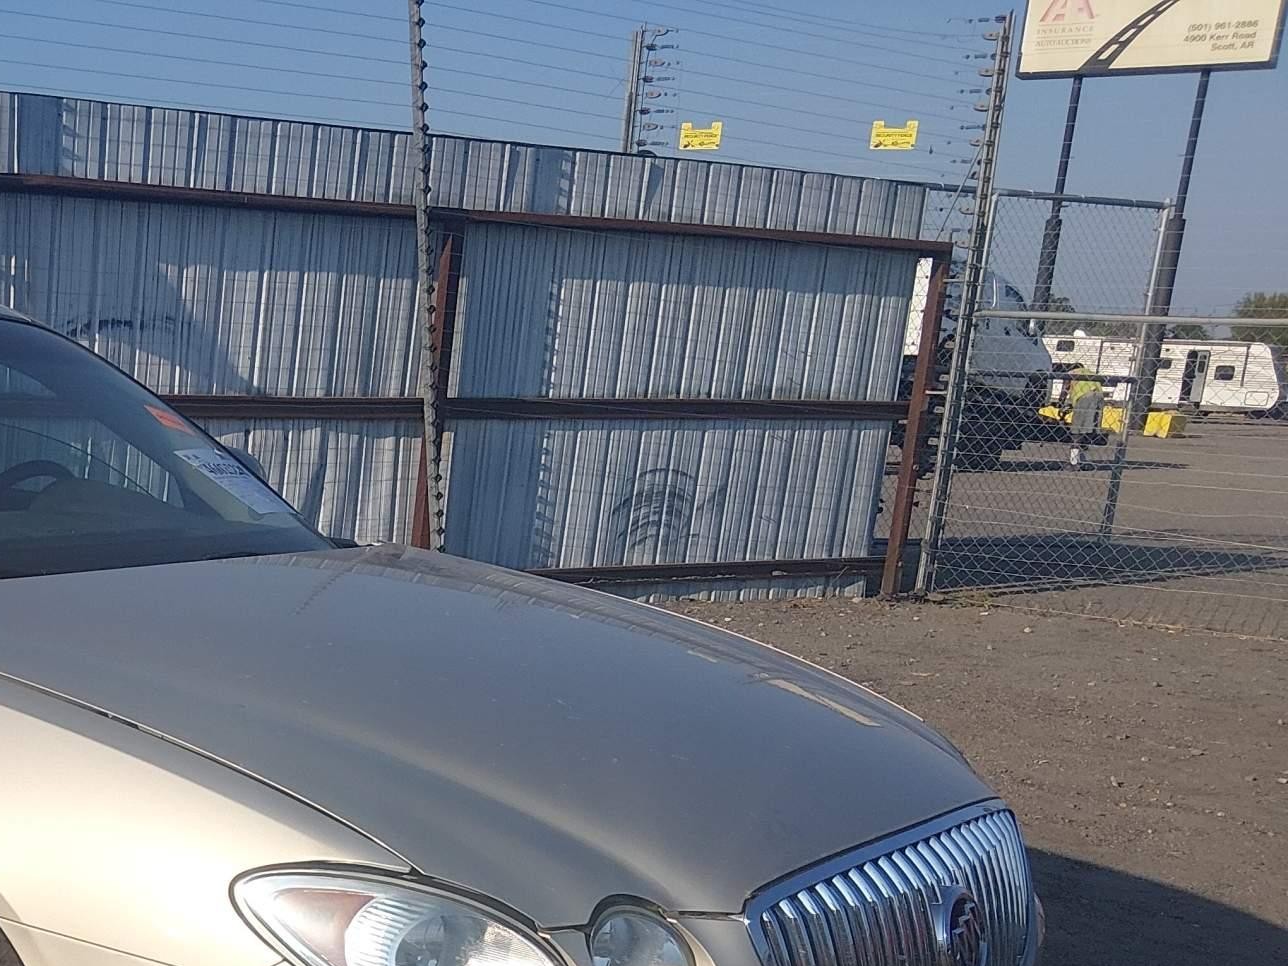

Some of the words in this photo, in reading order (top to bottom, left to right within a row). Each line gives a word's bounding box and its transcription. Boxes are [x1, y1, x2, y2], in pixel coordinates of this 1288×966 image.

[1036, 25, 1094, 35] INSURANCE
[1187, 23, 1212, 33] (501)
[1183, 34, 1207, 42] 4900
[1209, 33, 1230, 41] Kerr
[1231, 31, 1257, 39] Road
[1239, 40, 1255, 49] AR
